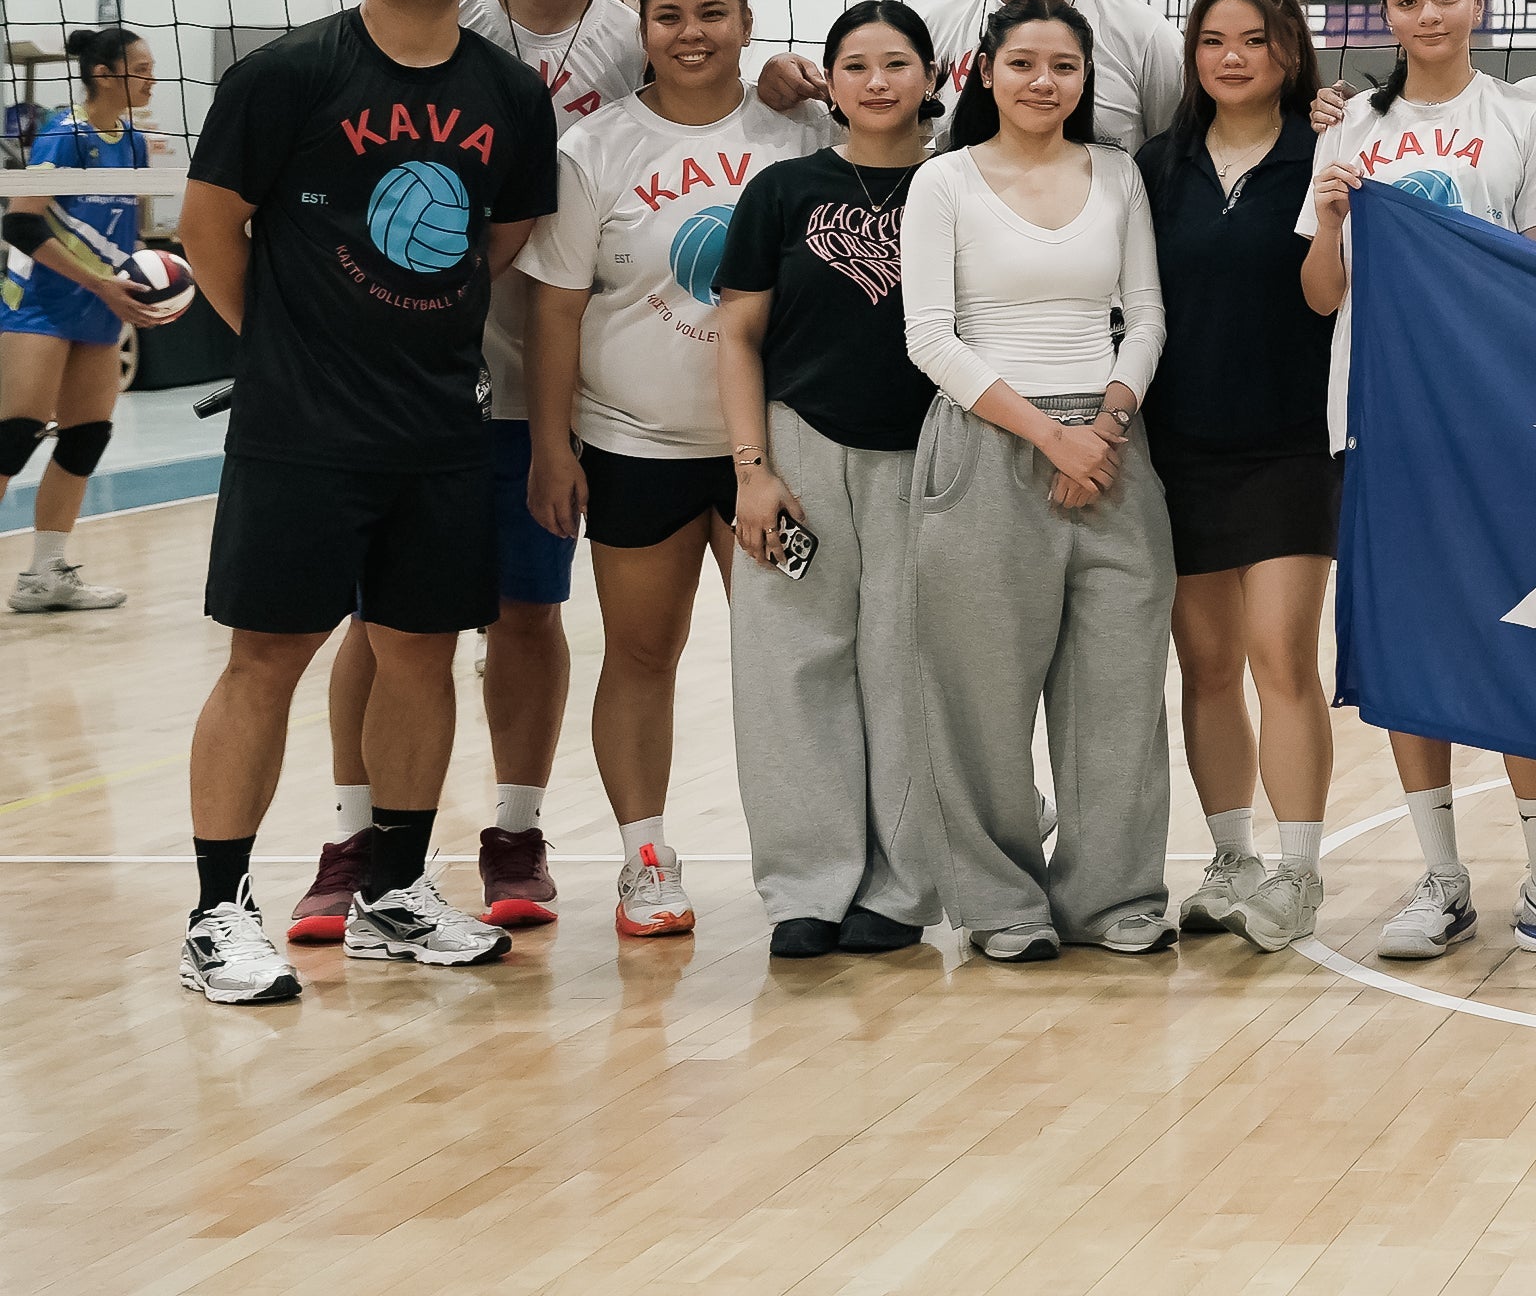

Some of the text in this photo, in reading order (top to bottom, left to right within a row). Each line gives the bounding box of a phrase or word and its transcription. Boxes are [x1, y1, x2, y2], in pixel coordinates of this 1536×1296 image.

[341, 104, 495, 165] KAVA
[1359, 129, 1484, 176] KAVA
[301, 193, 329, 205] EST.
[634, 152, 752, 212] KAV
[106, 208, 124, 236] 7
[806, 202, 905, 241] BLACKPI
[615, 254, 634, 264] EST.
[806, 232, 889, 261] WORLD
[335, 245, 453, 311] KAITO VOLLEYBALL
